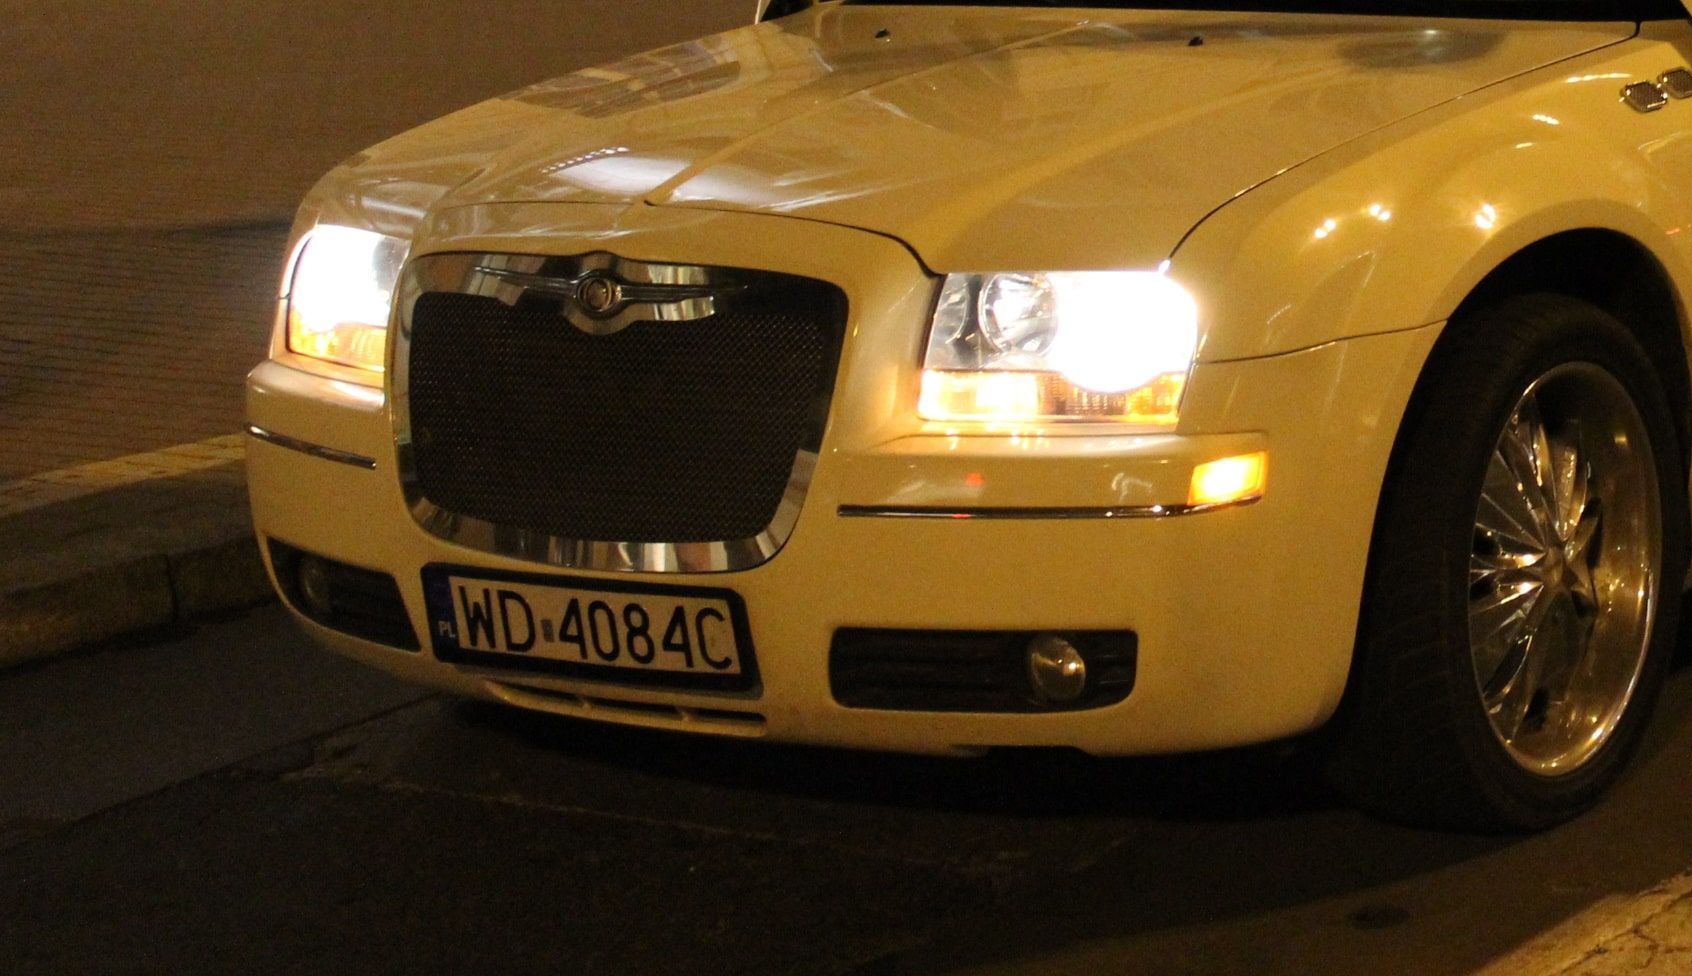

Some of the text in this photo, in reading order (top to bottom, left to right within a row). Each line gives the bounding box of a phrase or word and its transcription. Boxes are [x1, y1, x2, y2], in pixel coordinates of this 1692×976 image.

[438, 619, 457, 639] PL
[458, 584, 733, 671] WD 4084C
